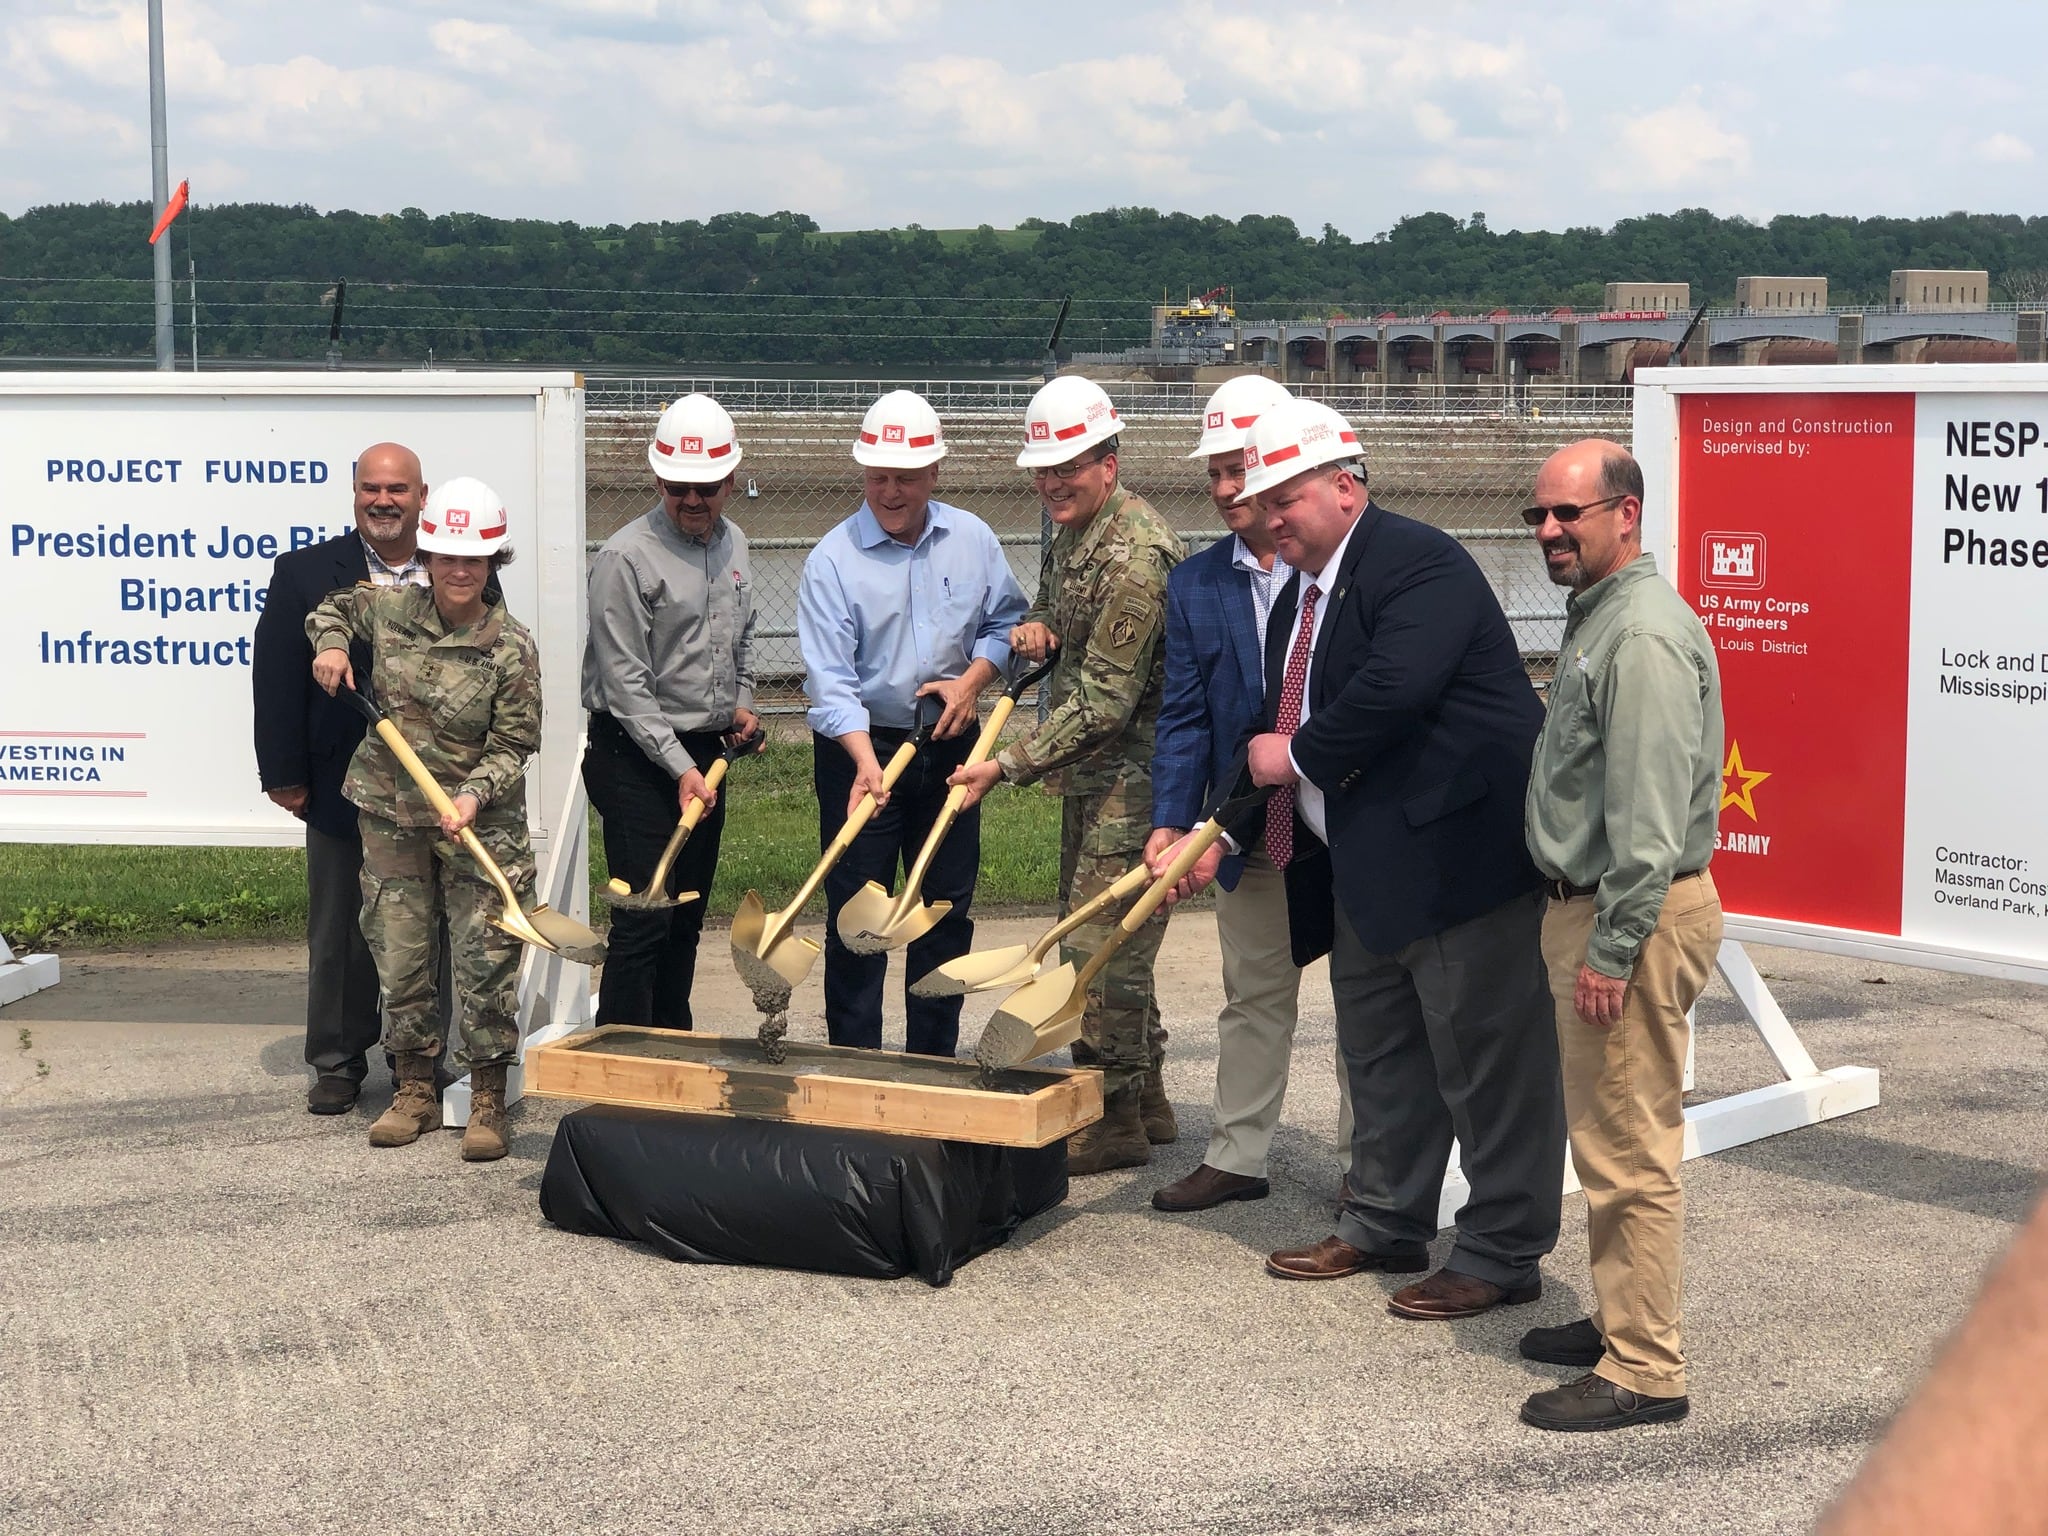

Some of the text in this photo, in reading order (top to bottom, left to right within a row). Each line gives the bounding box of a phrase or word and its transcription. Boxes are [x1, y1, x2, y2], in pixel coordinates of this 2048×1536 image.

[1703, 418, 1893, 436] Design and Construction
[1703, 439, 1810, 457] Supervised by:
[47, 459, 182, 482] PROJECT
[206, 460, 328, 483] FUNDED
[1945, 474, 2021, 512] New
[12, 523, 196, 558] President
[207, 526, 278, 559] Joe
[1944, 528, 2048, 568] Phase
[1699, 594, 1809, 616] US Army Corps
[1700, 613, 1788, 631] of Engineers
[1720, 637, 1808, 655] Louis District
[1942, 648, 1990, 669] Lock
[1996, 653, 2034, 672] and
[1940, 674, 2047, 705] Mississippi
[102, 746, 124, 761] IN
[1936, 846, 2028, 872] Contractor:
[1935, 867, 2048, 896] Massman Cons
[1934, 890, 1999, 910] Overland
[2002, 898, 2040, 918] Park,
